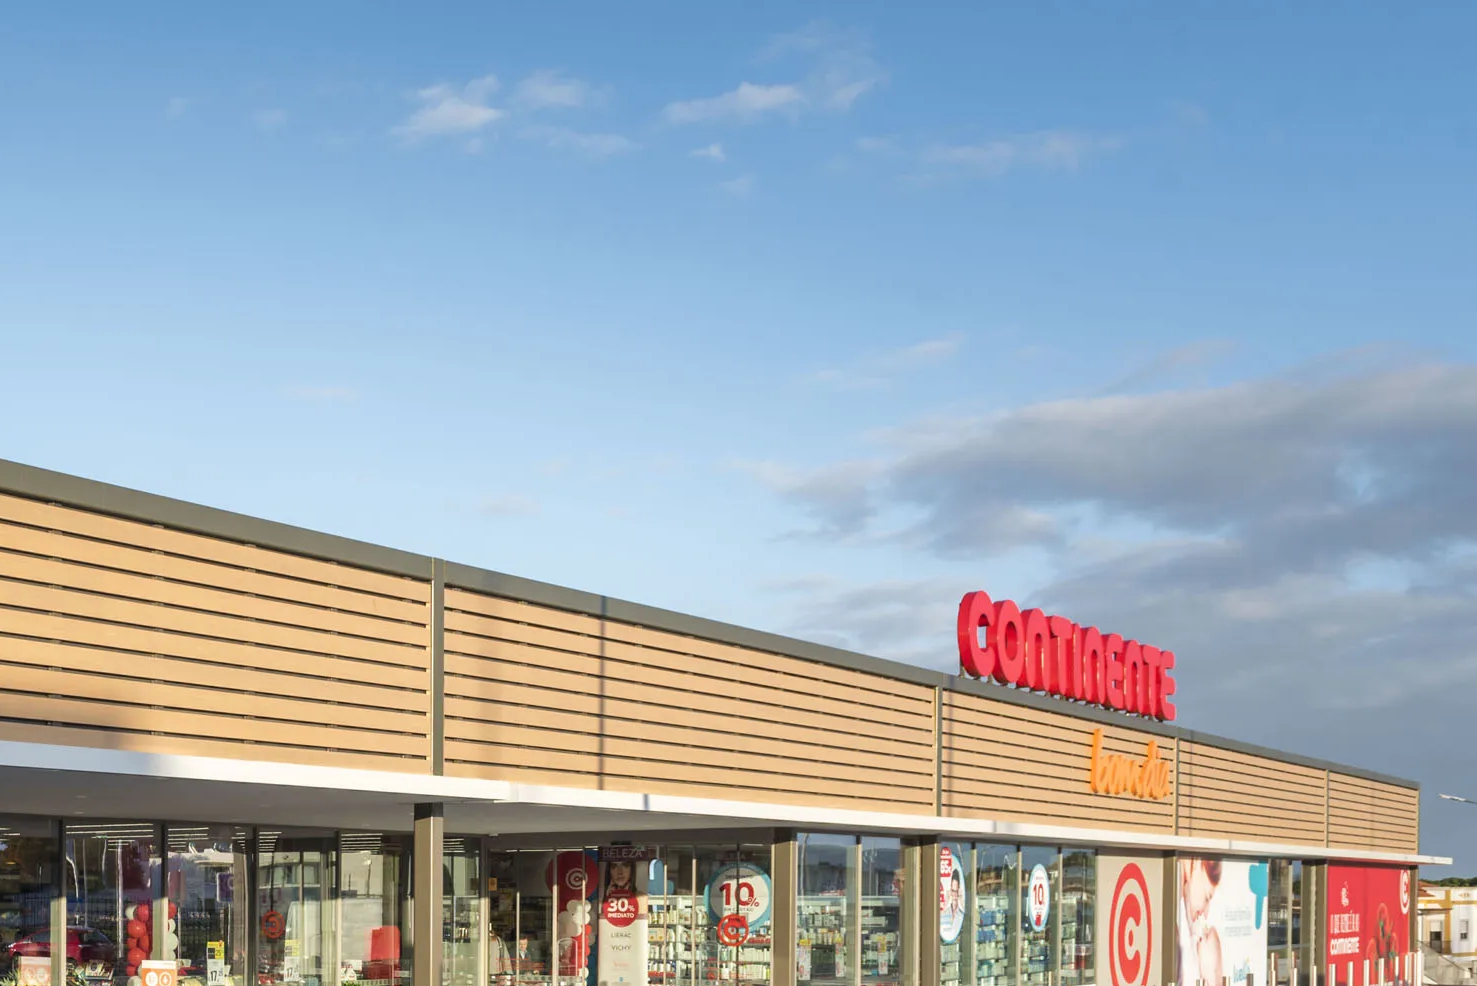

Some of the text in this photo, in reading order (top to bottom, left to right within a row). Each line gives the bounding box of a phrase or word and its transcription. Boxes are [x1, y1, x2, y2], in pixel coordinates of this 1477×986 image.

[957, 590, 1176, 721] CONTINENTE
[1090, 728, 1172, 800] bom dia
[607, 897, 635, 912] 30%
[719, 881, 760, 907] 10%
